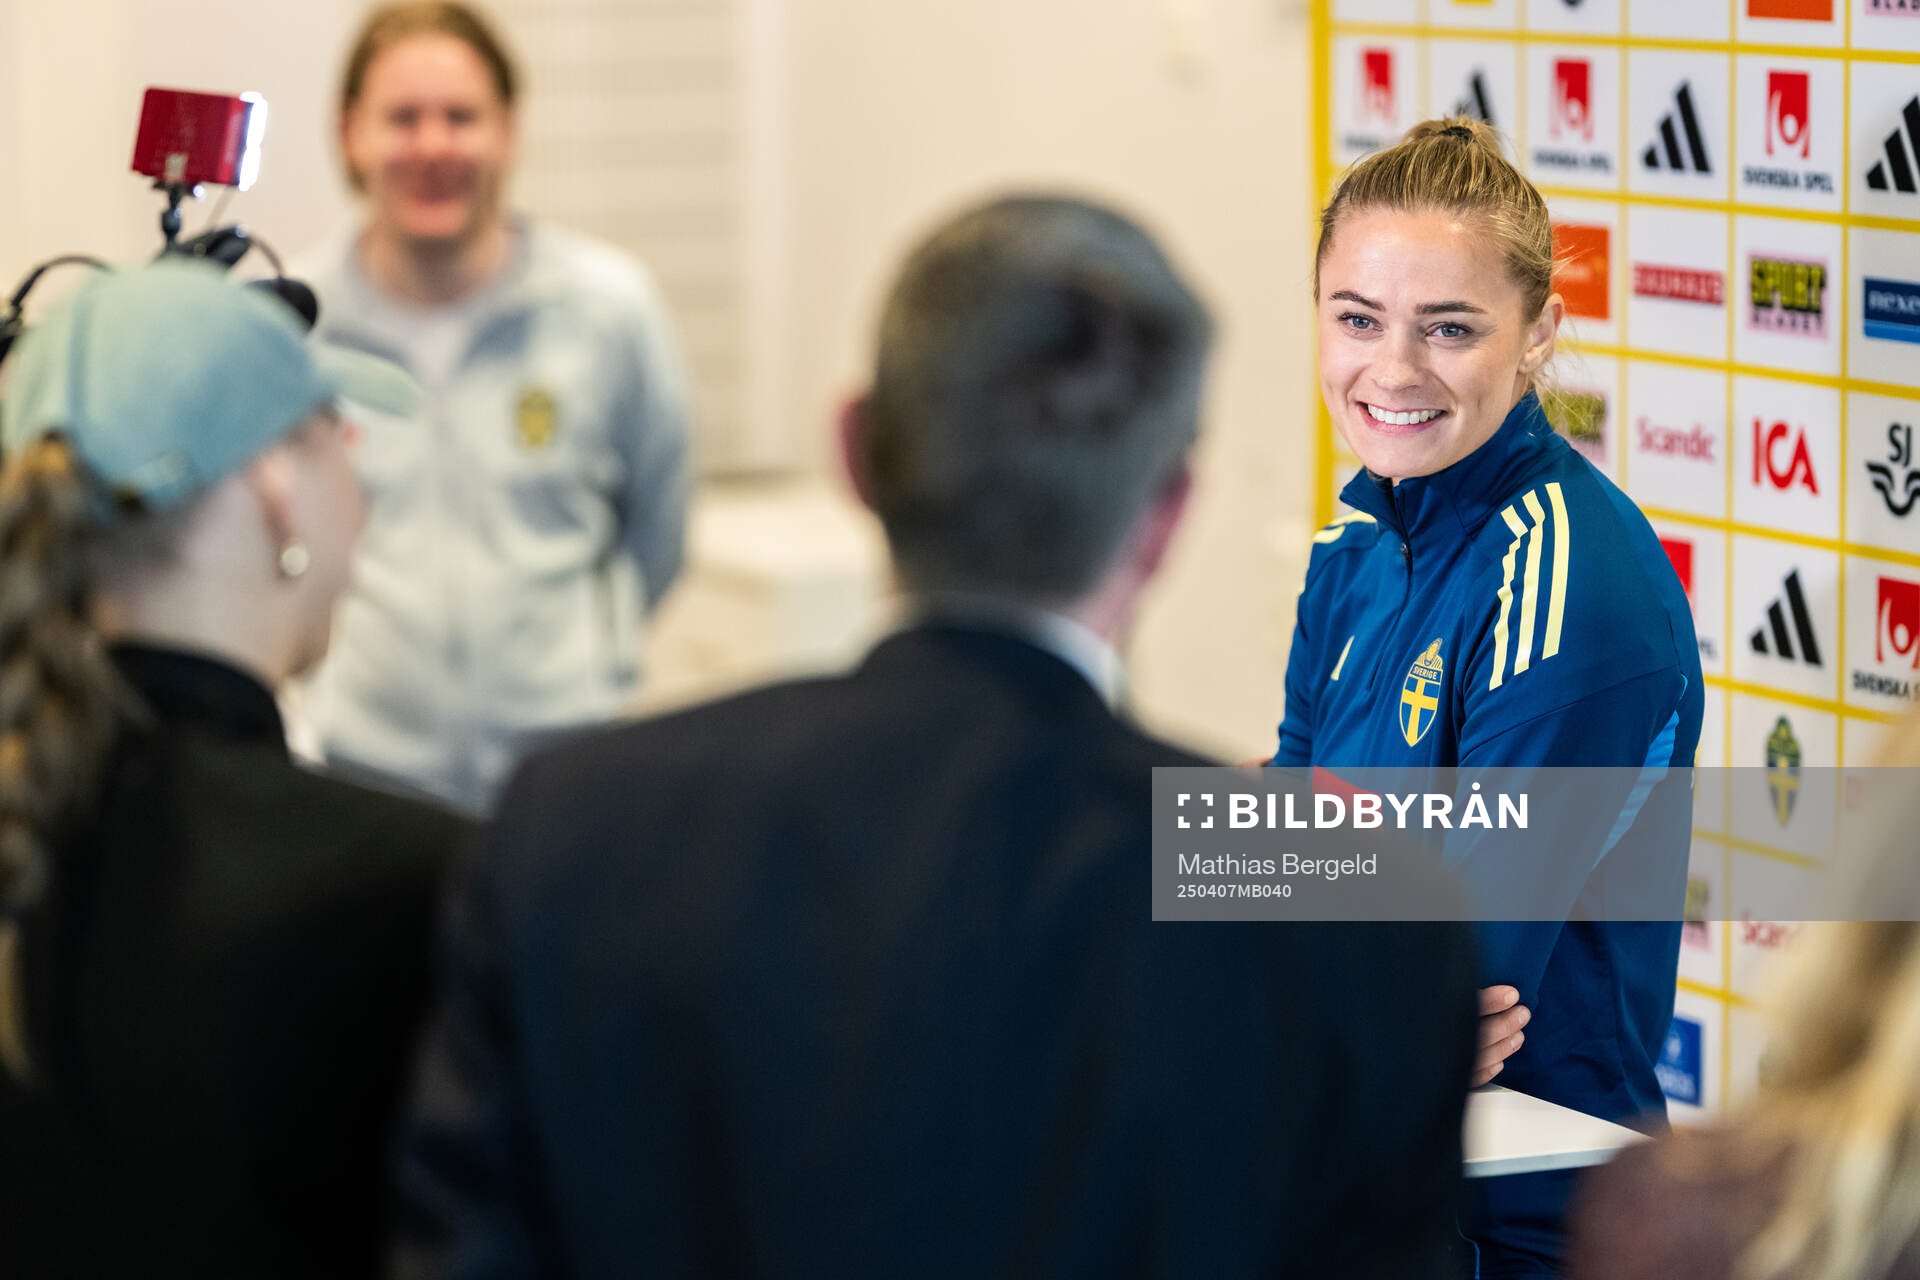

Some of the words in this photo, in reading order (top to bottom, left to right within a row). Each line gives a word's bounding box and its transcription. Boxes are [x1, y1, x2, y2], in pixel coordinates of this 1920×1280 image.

[1753, 417, 1819, 496] ICA
[1889, 423, 1912, 467] SJ
[1413, 665, 1437, 680] SVERIGE
